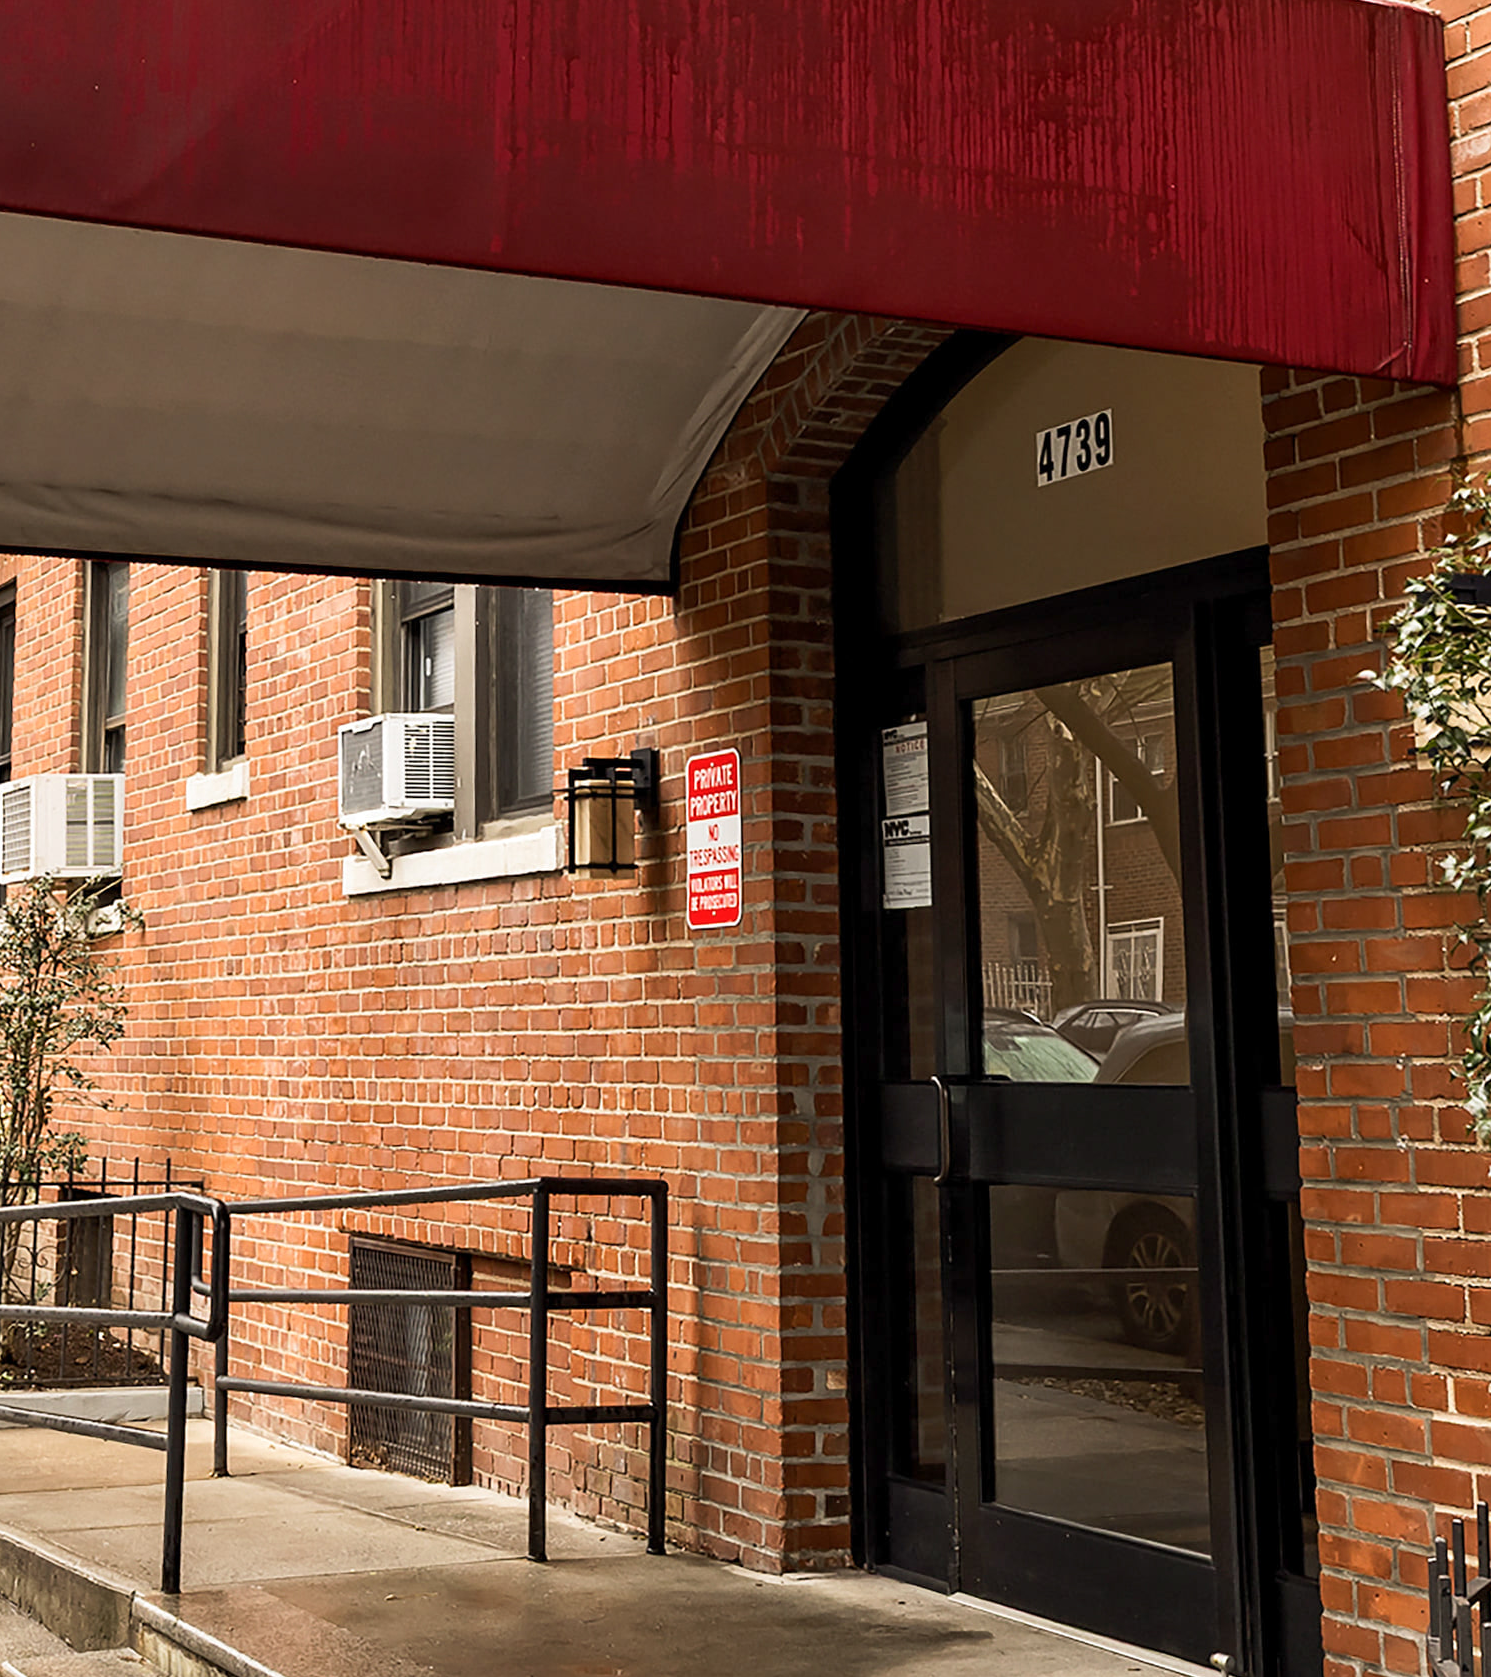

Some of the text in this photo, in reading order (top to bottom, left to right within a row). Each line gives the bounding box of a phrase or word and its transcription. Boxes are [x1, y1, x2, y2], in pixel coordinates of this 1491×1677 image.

[1039, 412, 1110, 482] 4739
[895, 739, 925, 754] NOTICE
[694, 763, 733, 790] PRIVATE
[690, 790, 737, 817] PROPERTY
[708, 824, 719, 841] NO
[884, 820, 909, 837] NYC
[689, 844, 739, 868] TRESPASSING
[691, 875, 722, 893] VIOLATORS
